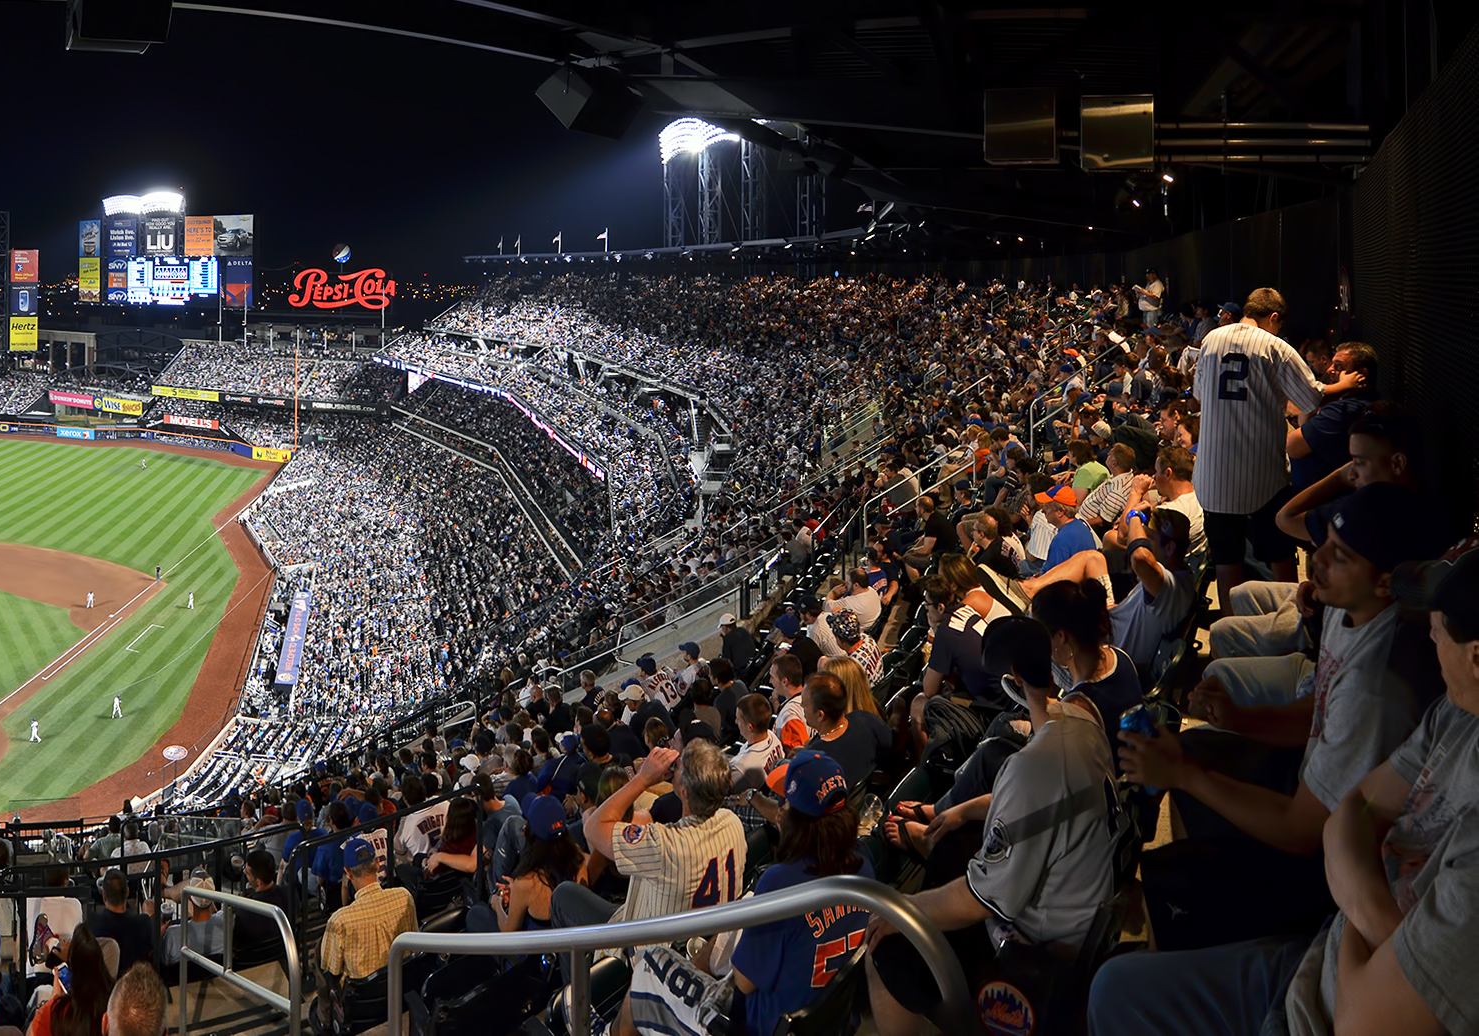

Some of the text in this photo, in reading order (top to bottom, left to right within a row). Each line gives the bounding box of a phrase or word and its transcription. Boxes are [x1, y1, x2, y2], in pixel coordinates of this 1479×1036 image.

[1218, 353, 1249, 401] 2
[170, 415, 212, 428] MODELL'S
[660, 682, 677, 704] 13
[692, 848, 735, 908] 41
